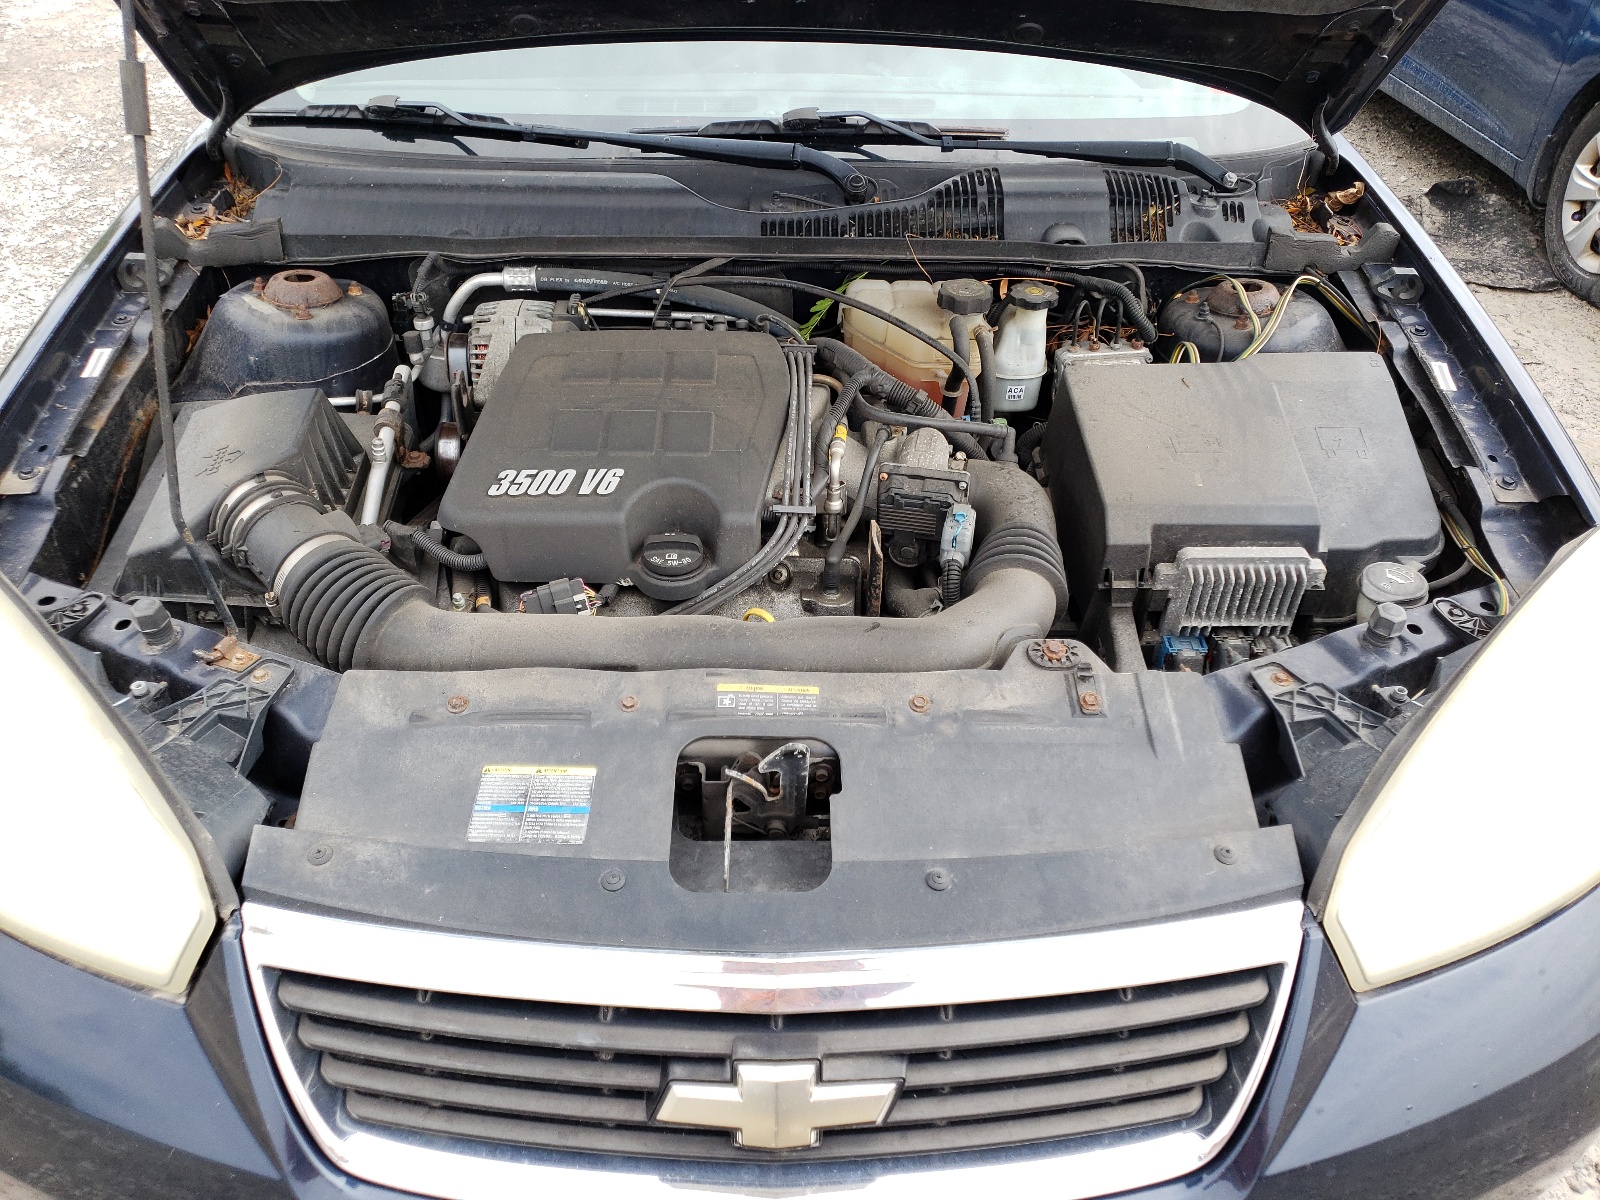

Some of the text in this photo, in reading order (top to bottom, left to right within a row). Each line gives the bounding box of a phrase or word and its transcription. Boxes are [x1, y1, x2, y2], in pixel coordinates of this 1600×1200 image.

[487, 468, 625, 496] 3500 V6
[650, 556, 692, 566] SAE 5W-30
